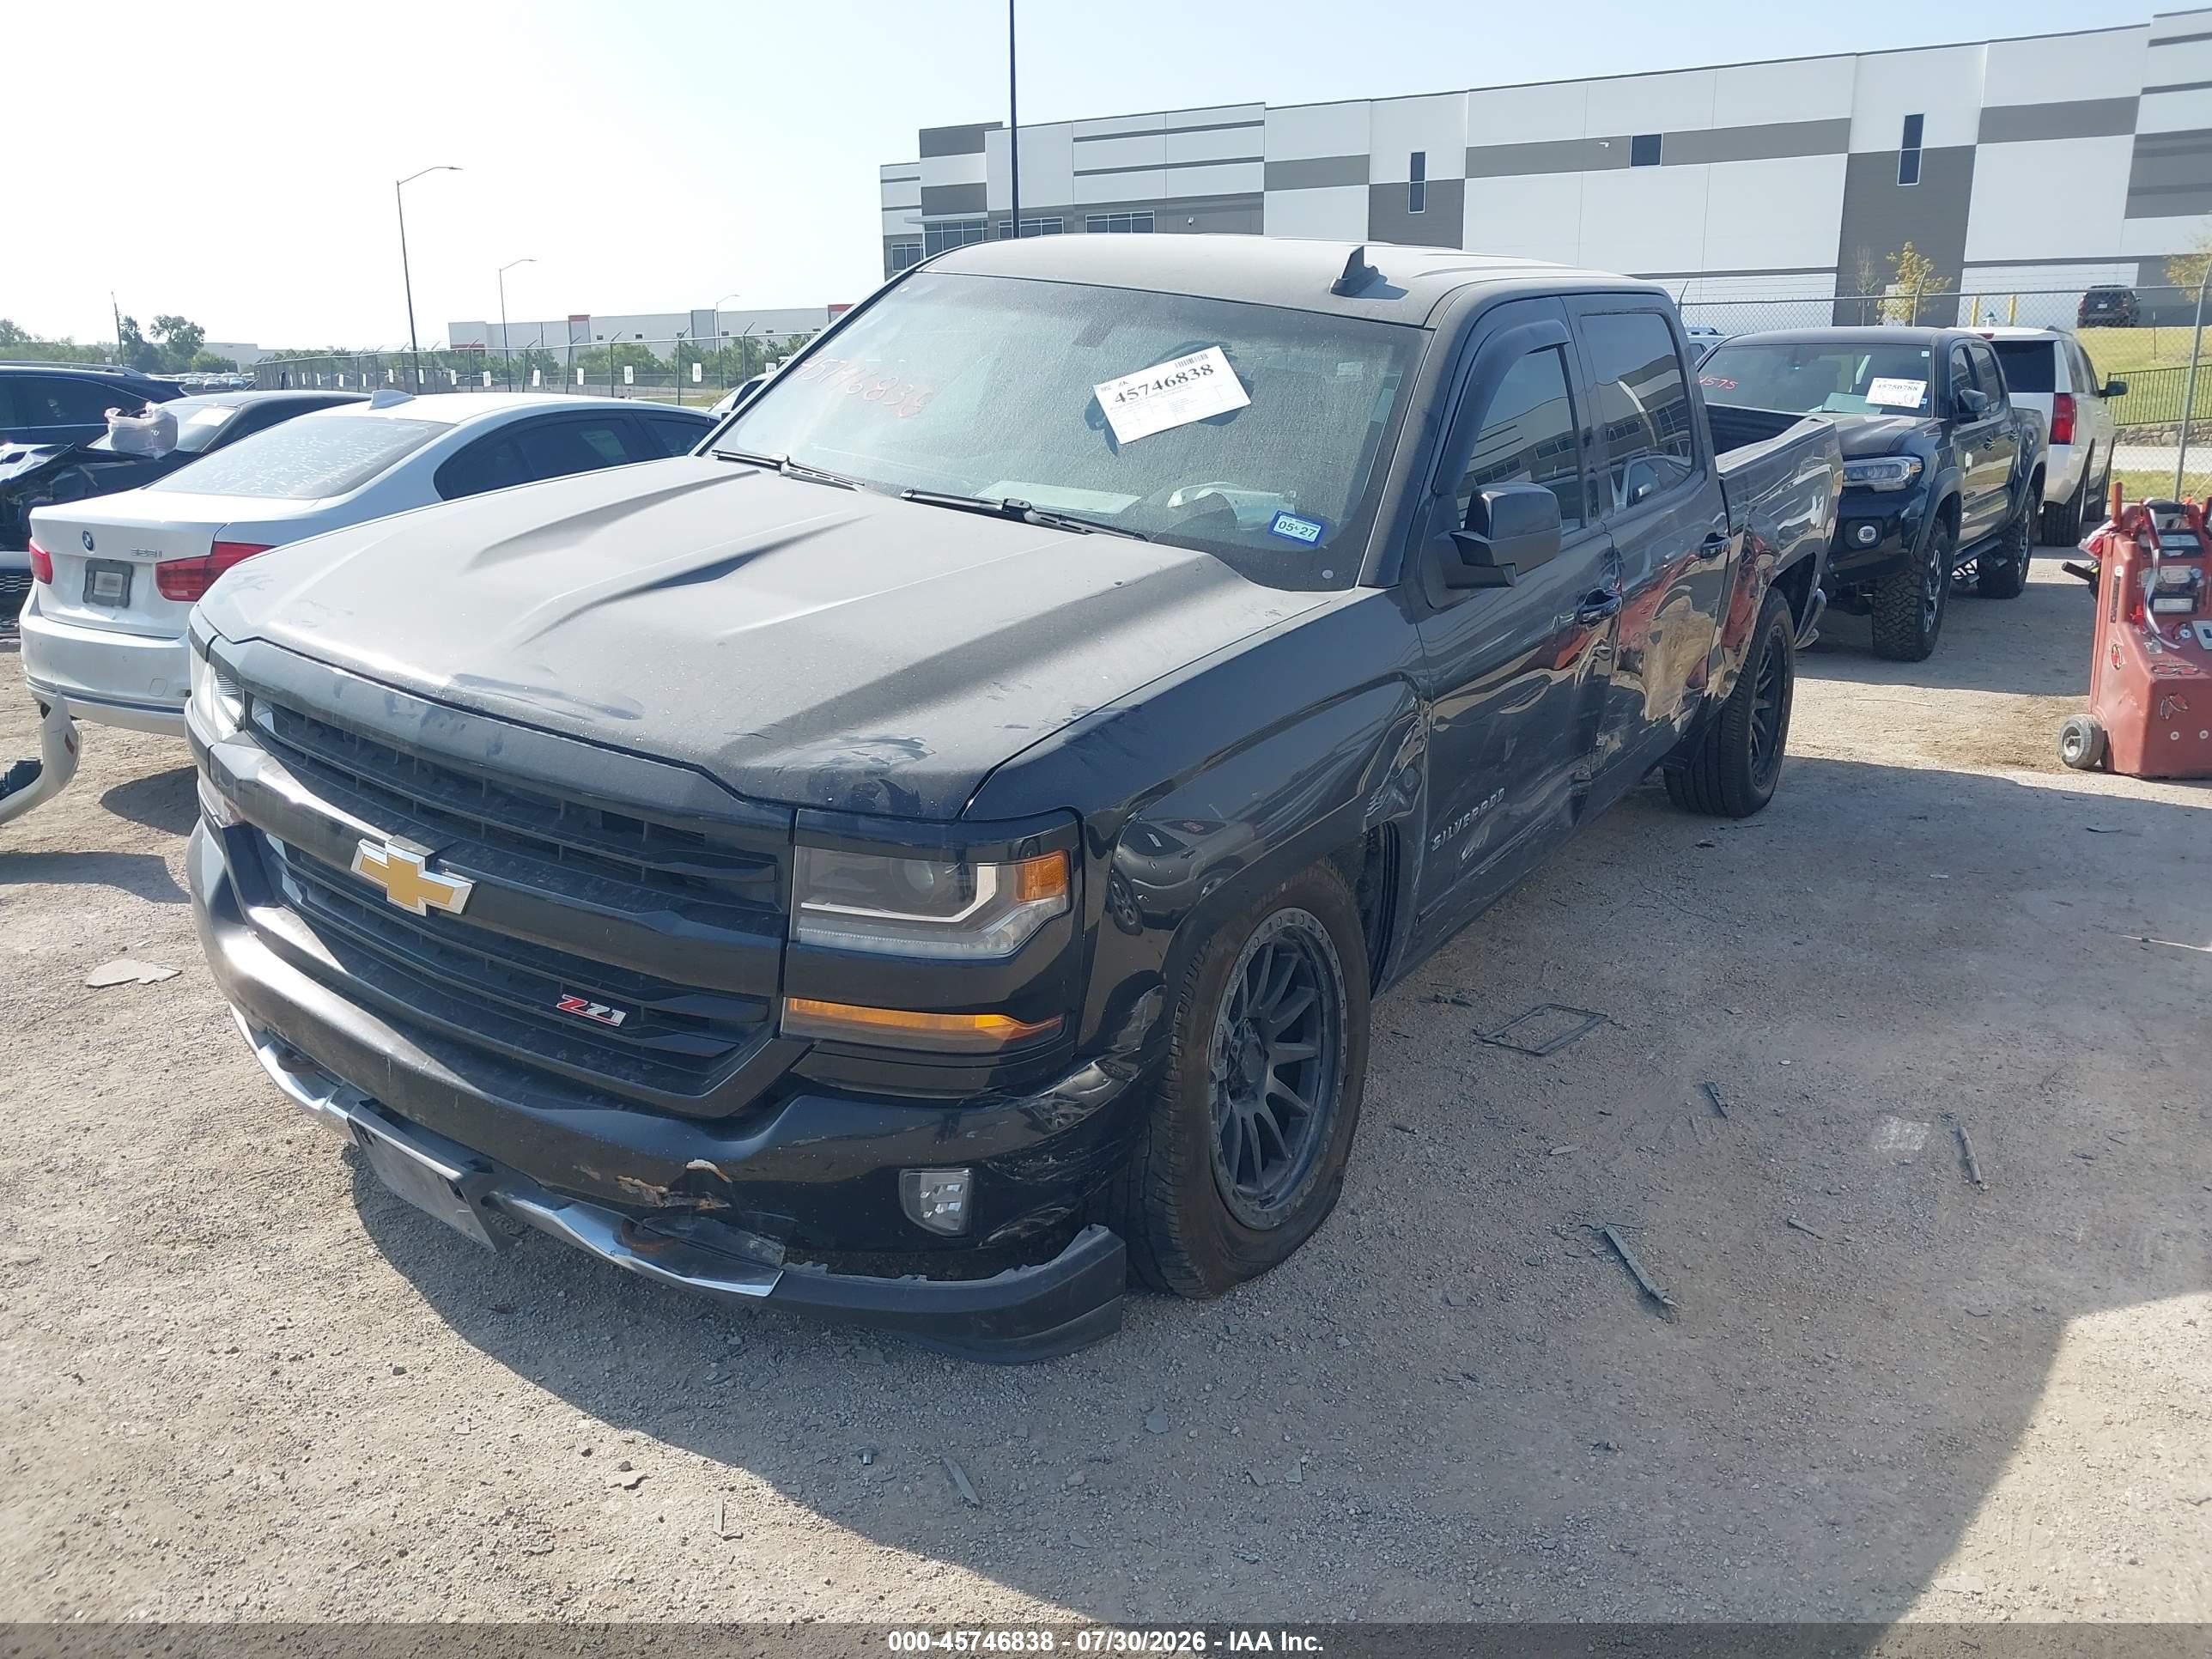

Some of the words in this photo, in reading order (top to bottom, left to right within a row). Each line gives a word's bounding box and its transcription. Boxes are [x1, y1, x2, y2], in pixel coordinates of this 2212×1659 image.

[1115, 364, 1214, 404] 45746838
[1279, 520, 1295, 532] 05
[1299, 526, 1316, 538] 27
[556, 994, 627, 1027] Z71
